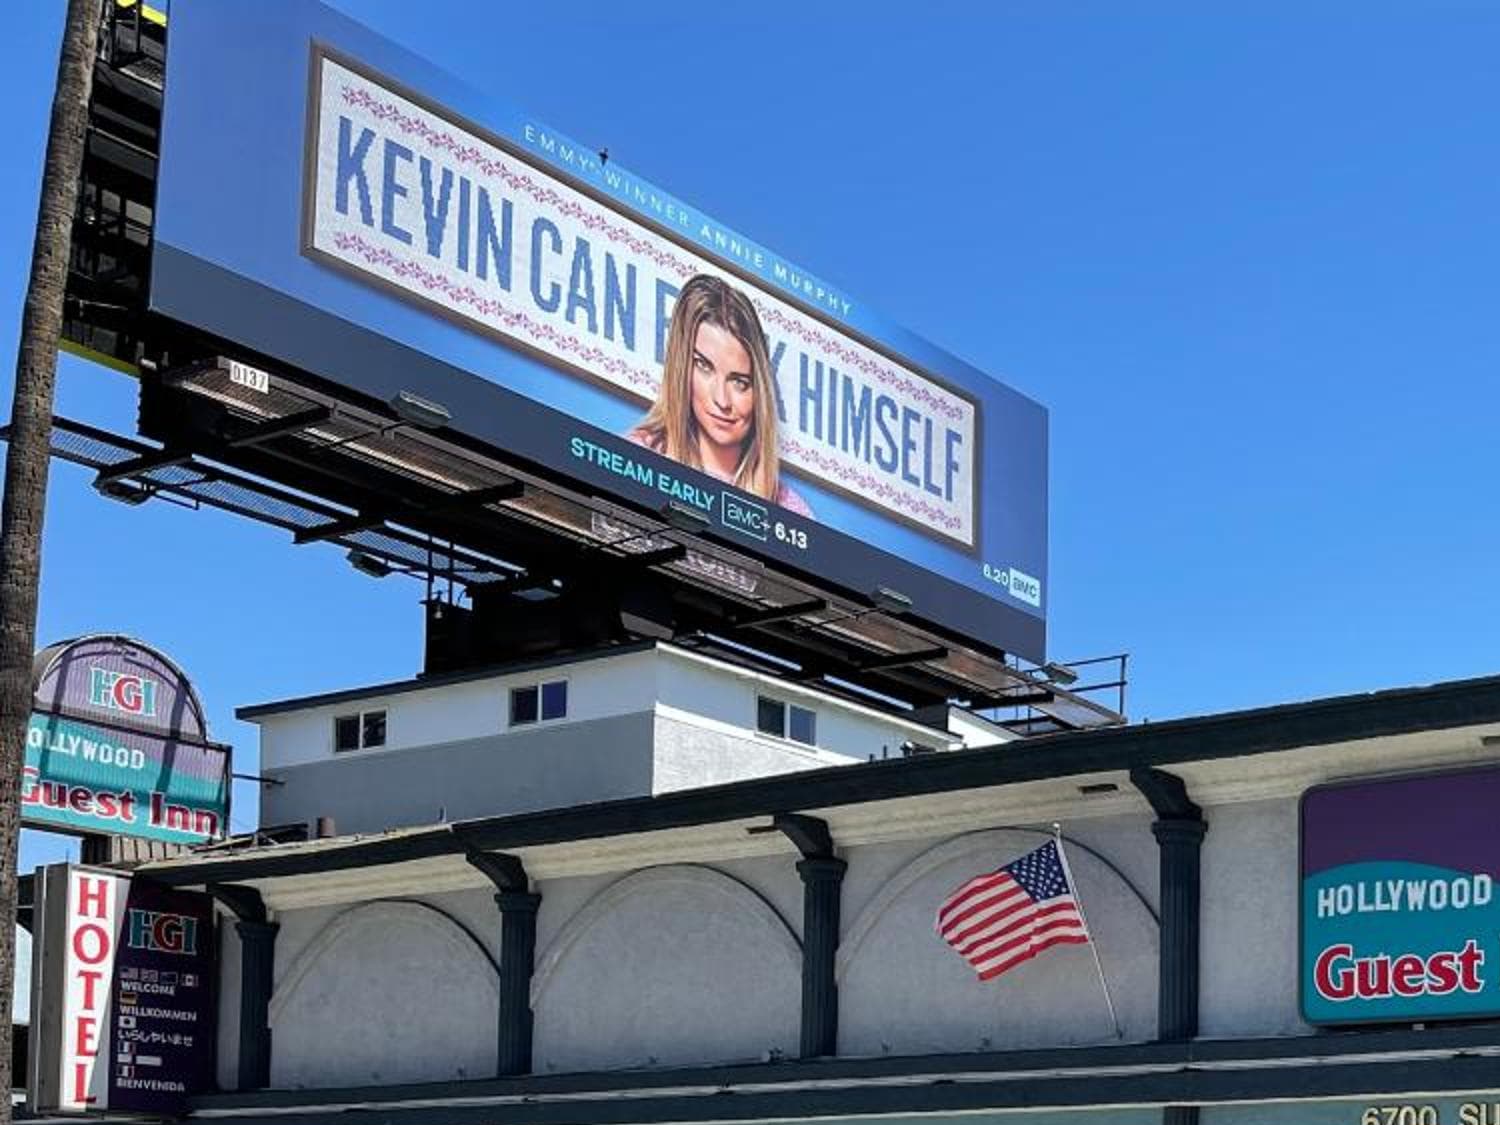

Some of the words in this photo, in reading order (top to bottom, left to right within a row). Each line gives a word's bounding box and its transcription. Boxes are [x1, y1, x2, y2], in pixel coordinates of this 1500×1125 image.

[604, 168, 690, 227] WINNER
[700, 224, 764, 268] ANNIE
[774, 262, 852, 316] MURPHY
[335, 115, 513, 292] KEVIN
[530, 216, 637, 352] CAN
[799, 351, 963, 502] HIMSELF
[233, 364, 266, 389] 0137
[570, 437, 654, 488] STREAM
[657, 473, 715, 512] EARLY
[774, 521, 808, 550] 6.13
[983, 563, 1008, 587] 6.20
[89, 666, 157, 717] HGI
[27, 727, 145, 770] OLLYWOOD
[148, 791, 222, 839] Inn
[1317, 874, 1492, 918] HOLLYWOOD
[127, 907, 198, 956] HGI
[72, 877, 111, 1104] HOTEL
[120, 980, 176, 996] WELCOME
[1314, 939, 1484, 1001] Guest
[119, 1005, 198, 1022] WILLKOMMEN
